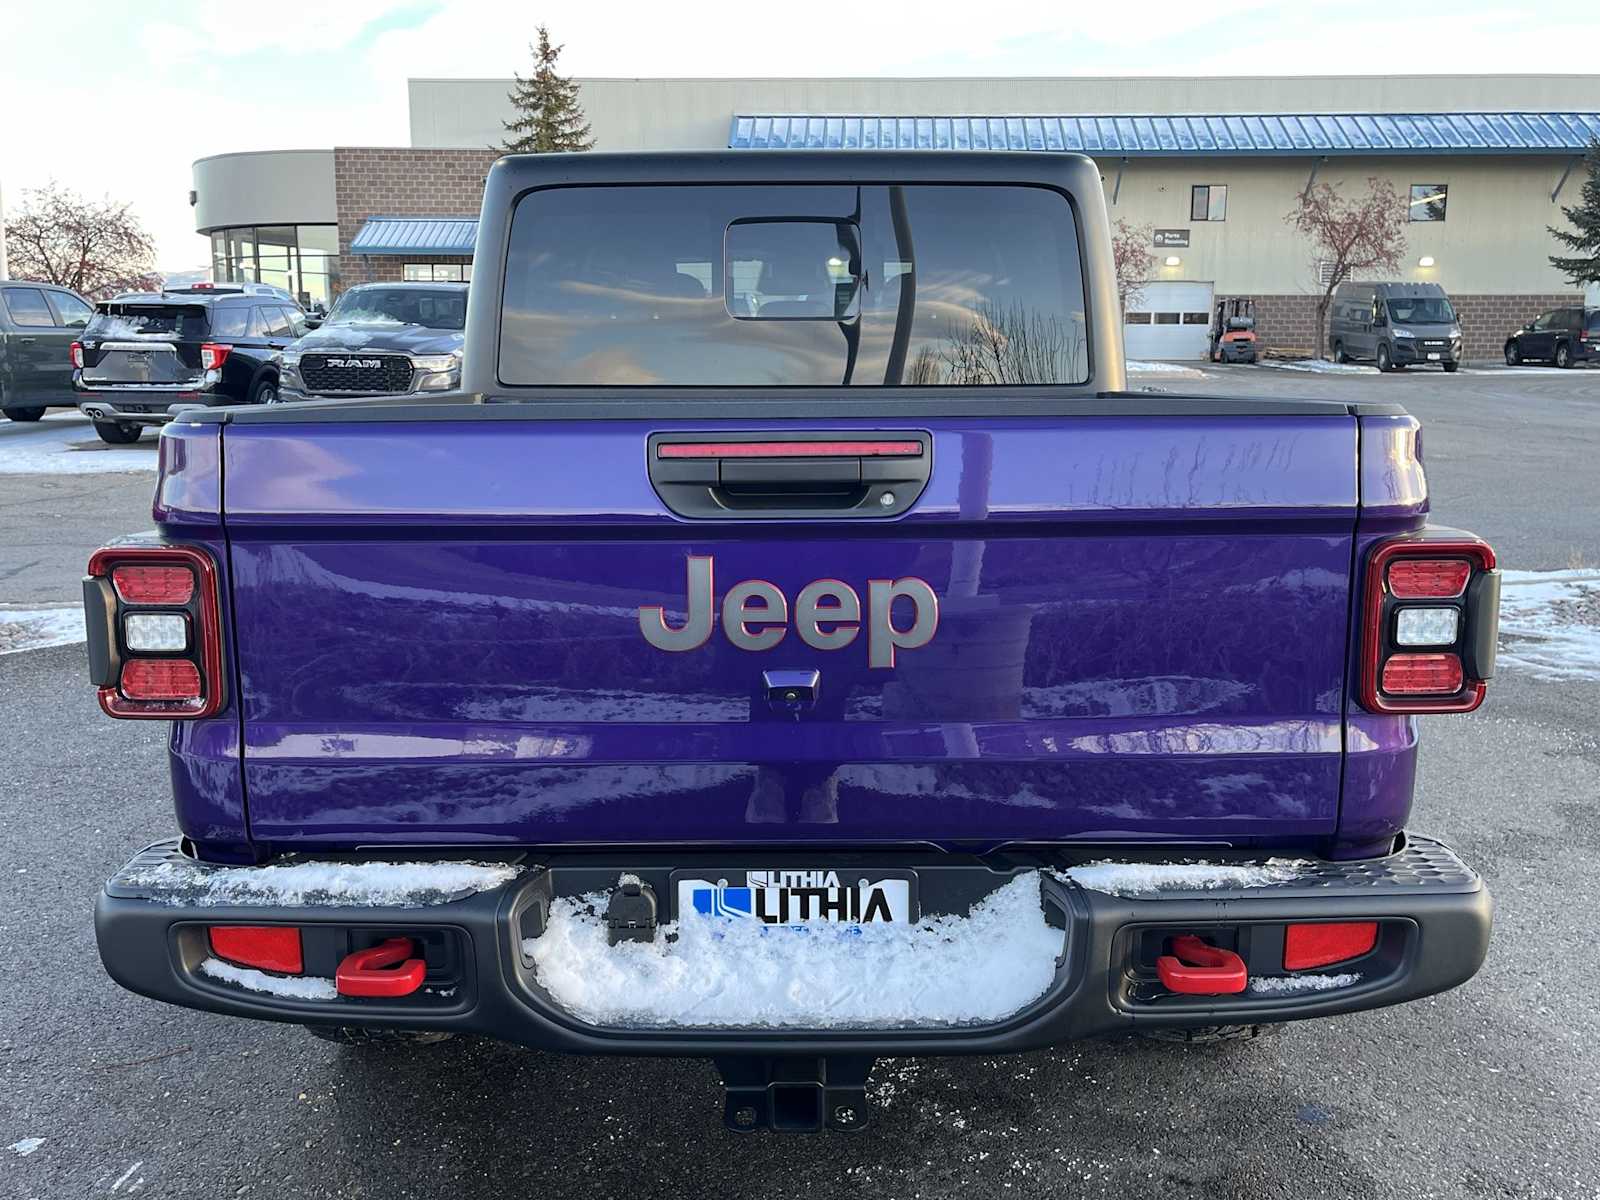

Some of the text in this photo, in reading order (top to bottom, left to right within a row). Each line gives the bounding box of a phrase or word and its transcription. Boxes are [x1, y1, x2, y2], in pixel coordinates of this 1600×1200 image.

[327, 359, 381, 368] RAM
[639, 555, 939, 669] Jeep
[767, 871, 841, 888] LITHIA
[756, 887, 893, 924] LITHIA
